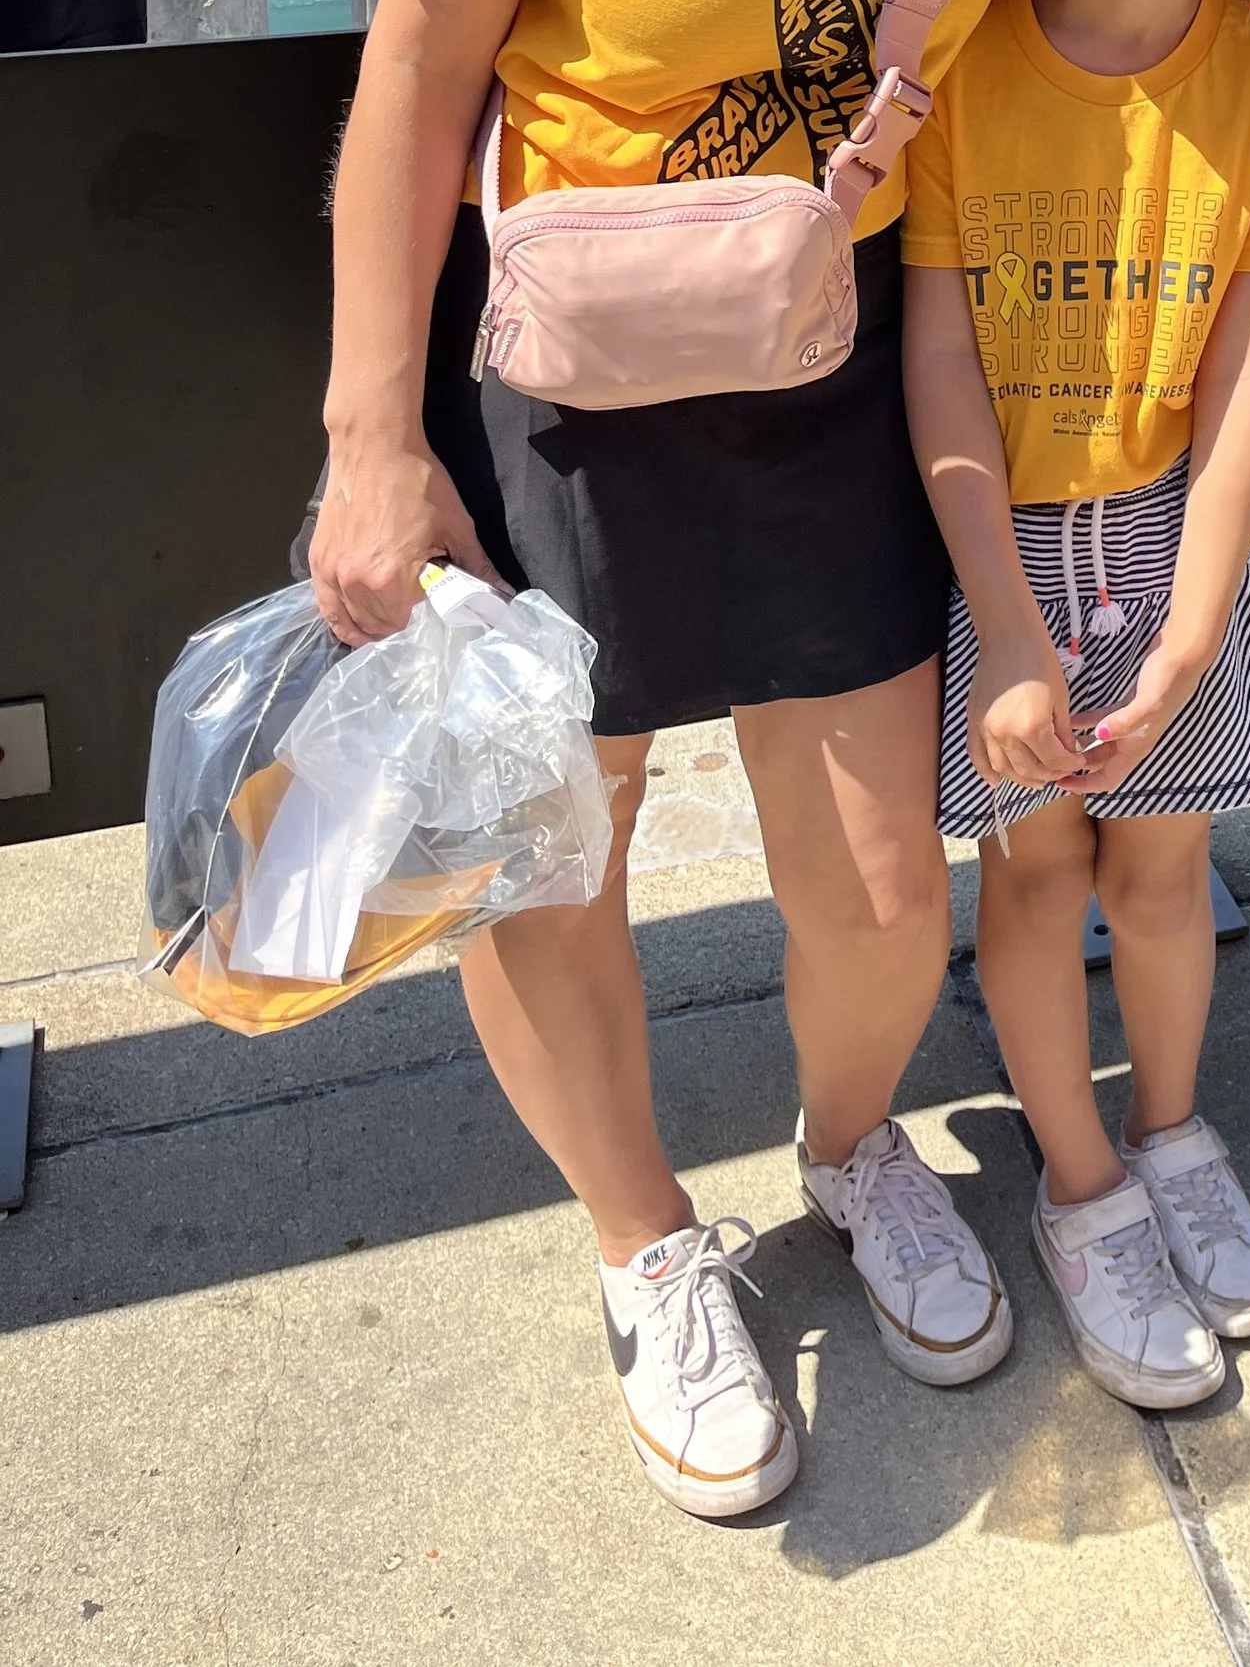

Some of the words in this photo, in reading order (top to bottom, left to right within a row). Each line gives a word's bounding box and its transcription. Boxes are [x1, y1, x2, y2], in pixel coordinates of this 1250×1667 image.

[665, 72, 768, 180] BRAVE
[678, 92, 788, 182] URAGE
[962, 188, 1225, 222] STRONGER
[962, 219, 1221, 263] STRONGER
[1049, 382, 1113, 400] CANCER
[1121, 381, 1193, 399] WAENESS
[642, 1243, 669, 1272] NIKE
